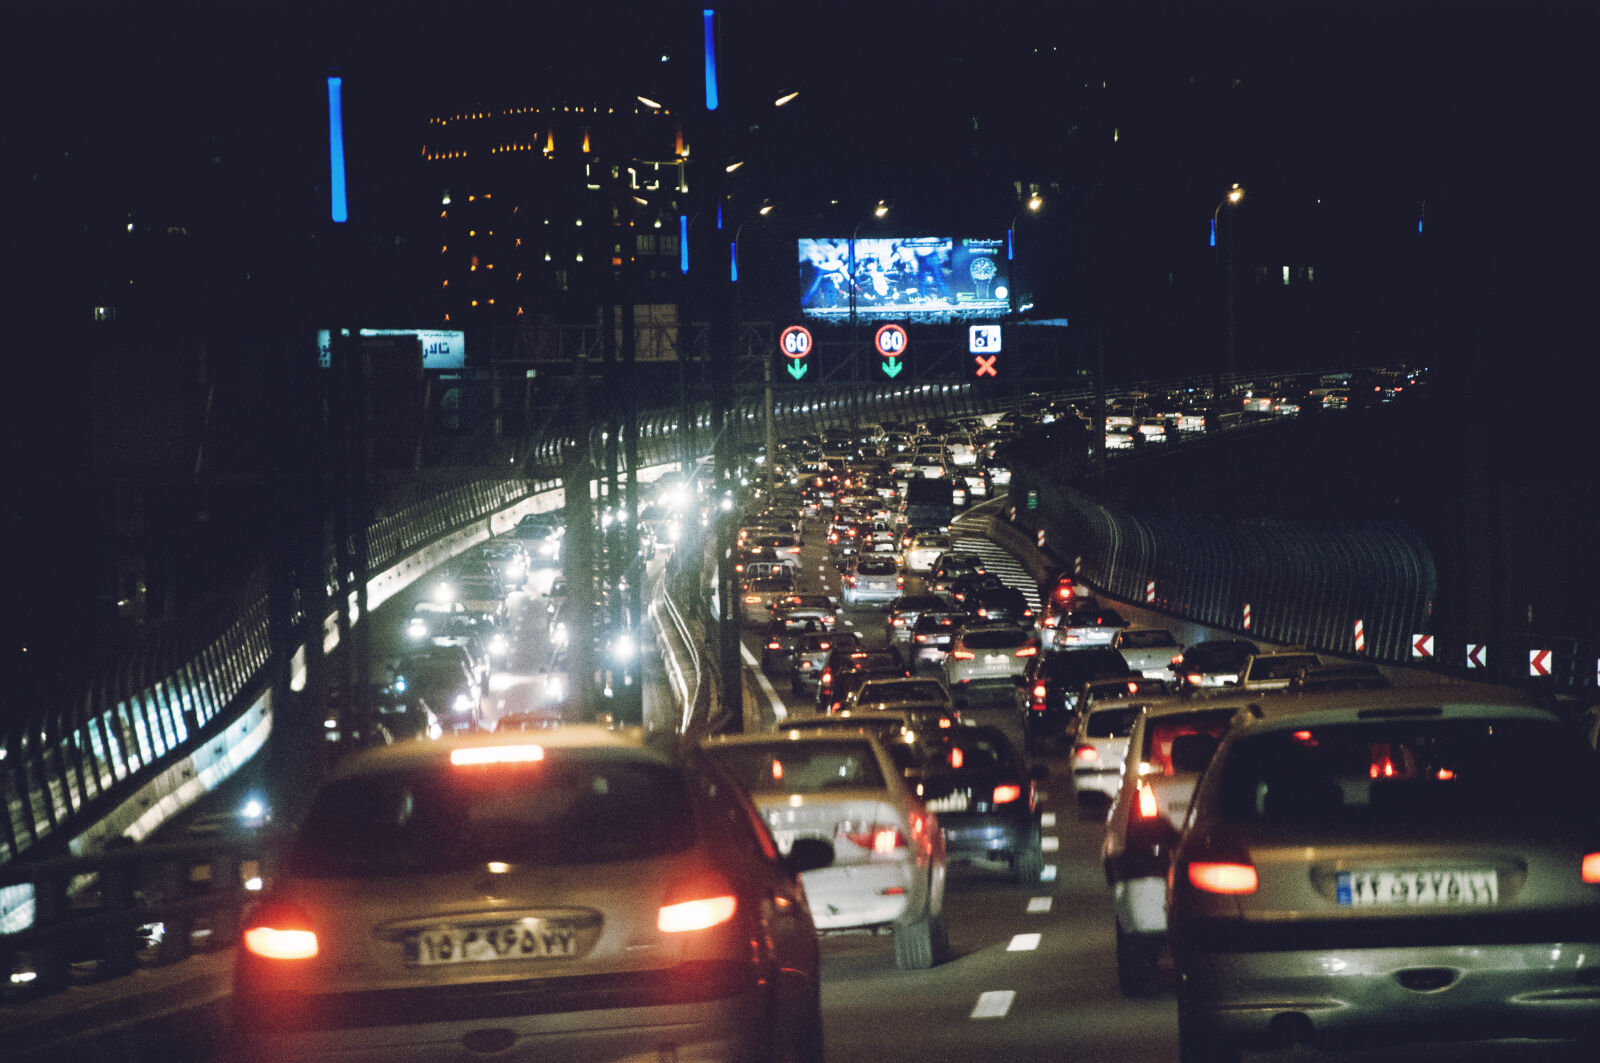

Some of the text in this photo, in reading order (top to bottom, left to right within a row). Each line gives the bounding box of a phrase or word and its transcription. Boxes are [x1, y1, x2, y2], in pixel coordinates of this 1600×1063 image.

[785, 332, 808, 352] 60
[880, 330, 903, 350] 60
[423, 342, 450, 359] تالار
